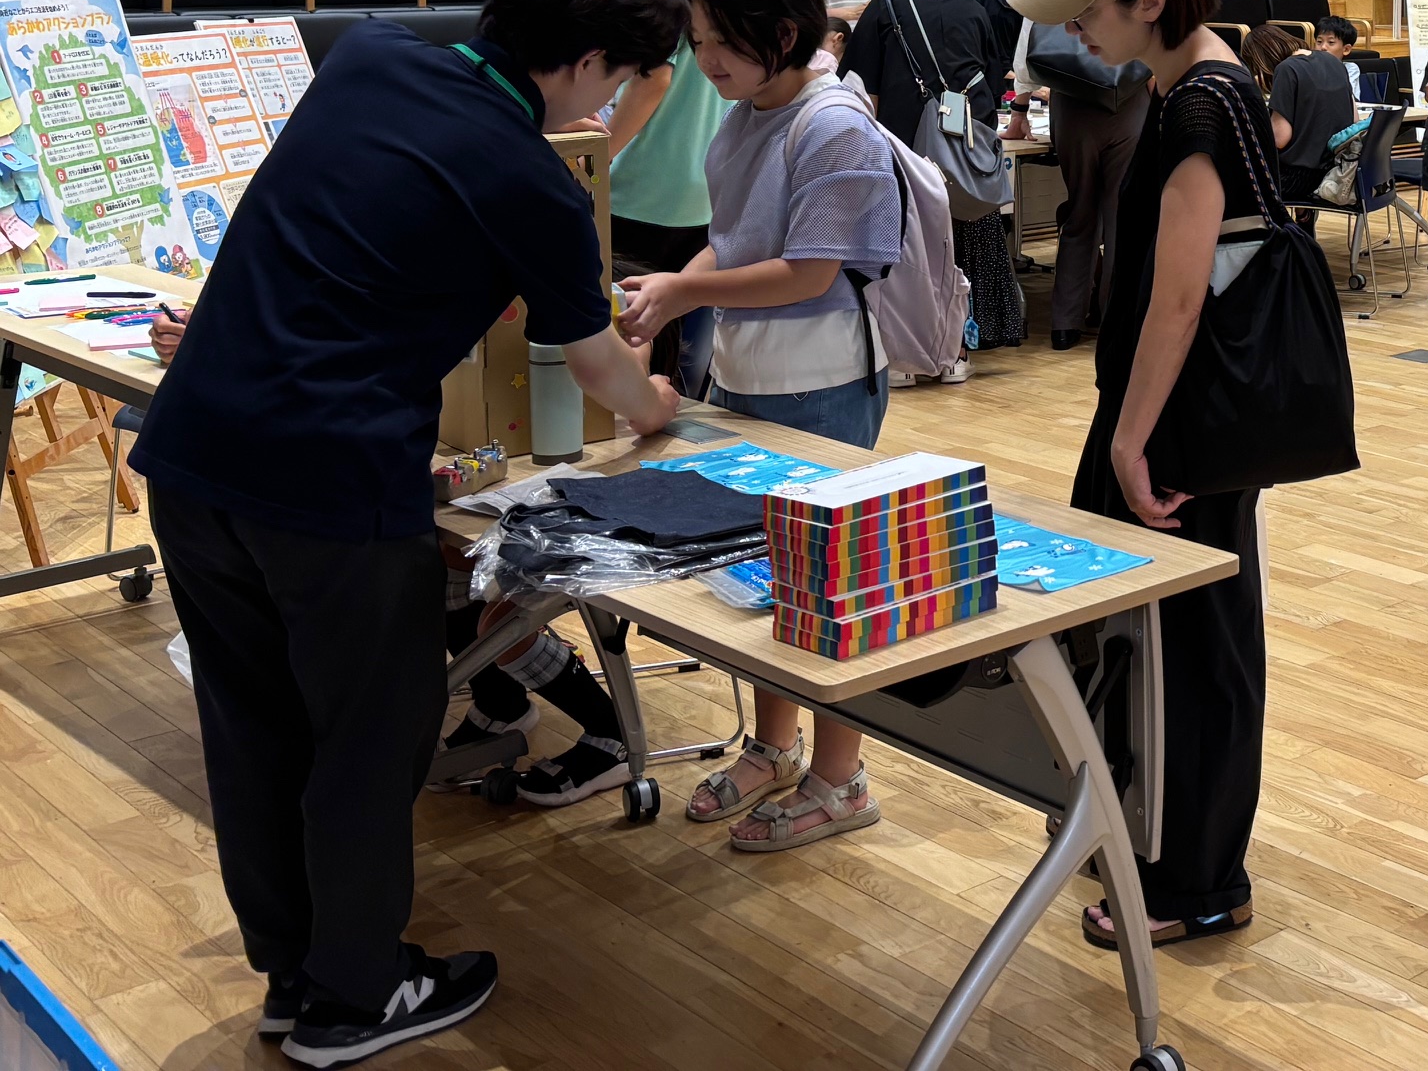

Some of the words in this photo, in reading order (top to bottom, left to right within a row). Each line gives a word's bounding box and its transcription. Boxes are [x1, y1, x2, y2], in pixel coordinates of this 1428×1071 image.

[7, 13, 113, 37] あらかわアクションプラン
[80, 84, 87, 95] 3
